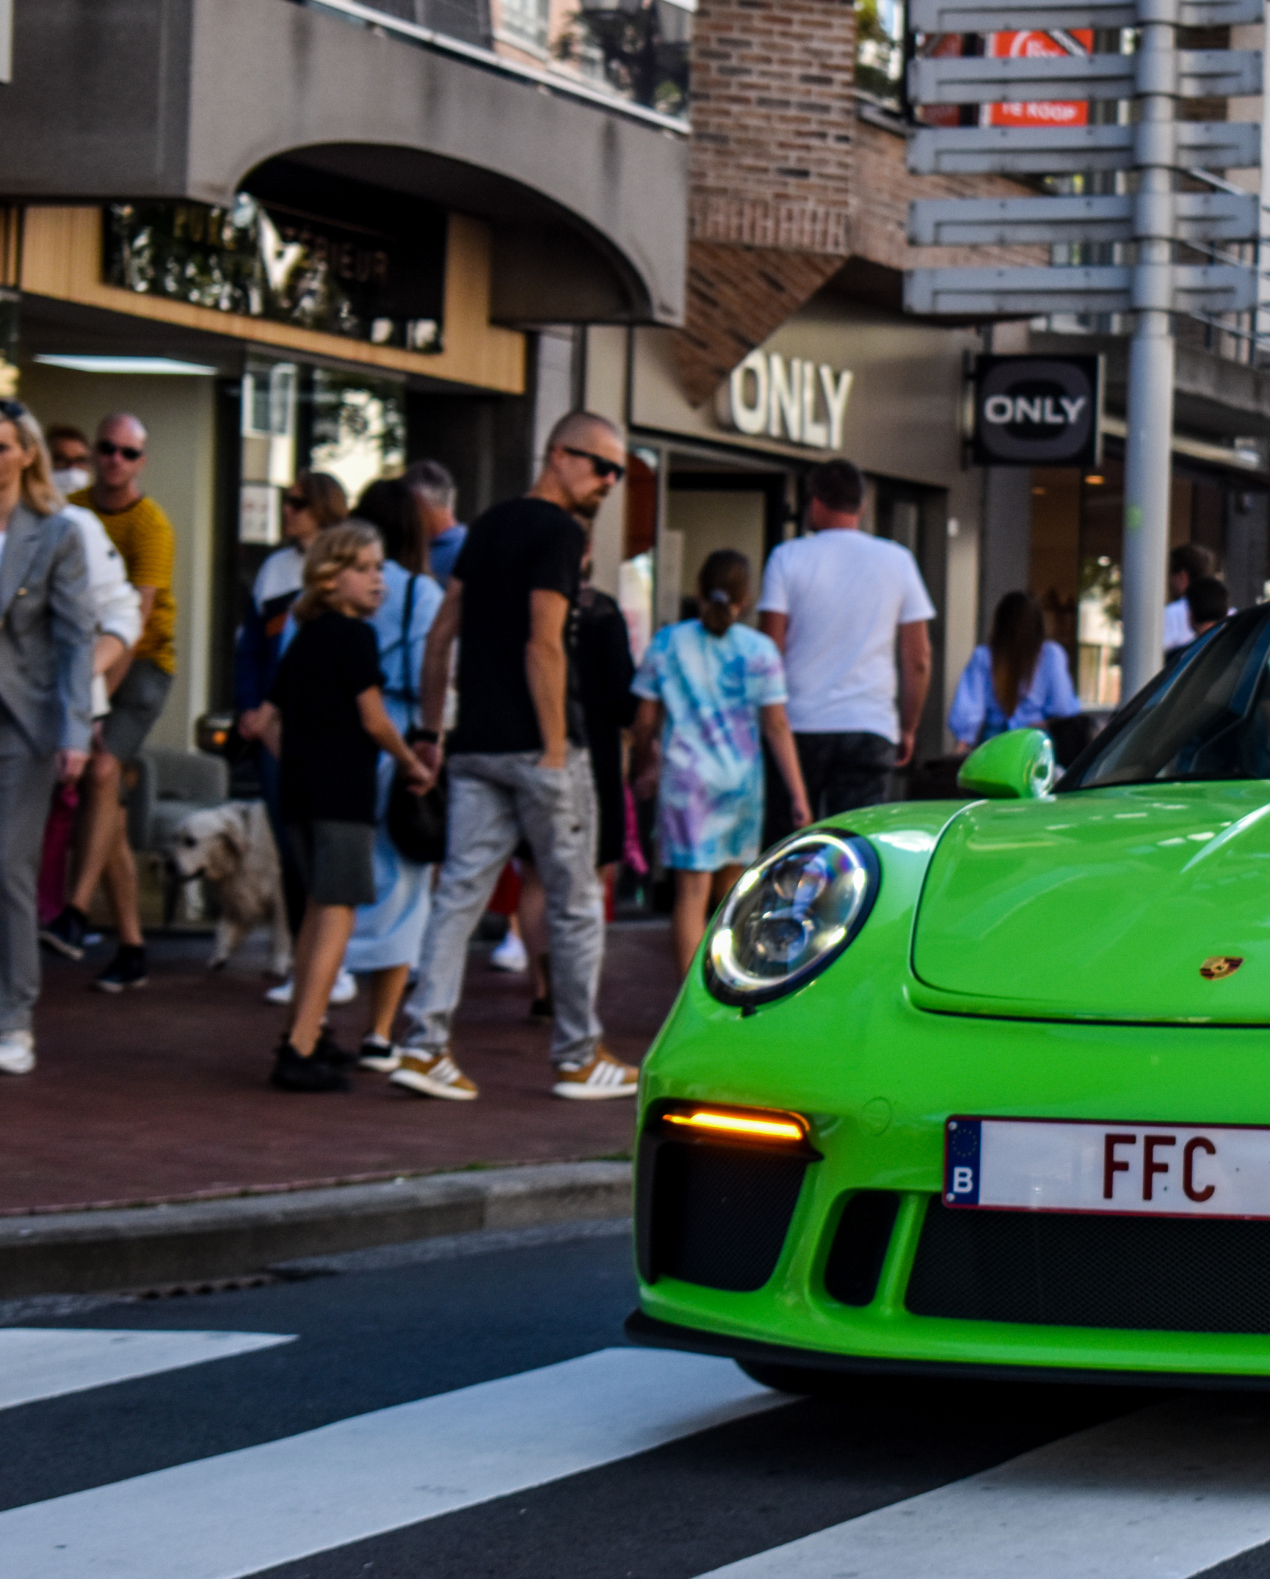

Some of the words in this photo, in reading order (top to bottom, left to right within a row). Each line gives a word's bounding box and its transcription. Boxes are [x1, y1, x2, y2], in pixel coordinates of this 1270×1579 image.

[731, 350, 853, 450] ONLY
[985, 395, 1085, 424] ONLY
[953, 1167, 973, 1193] B
[1103, 1133, 1217, 1202] FFC
